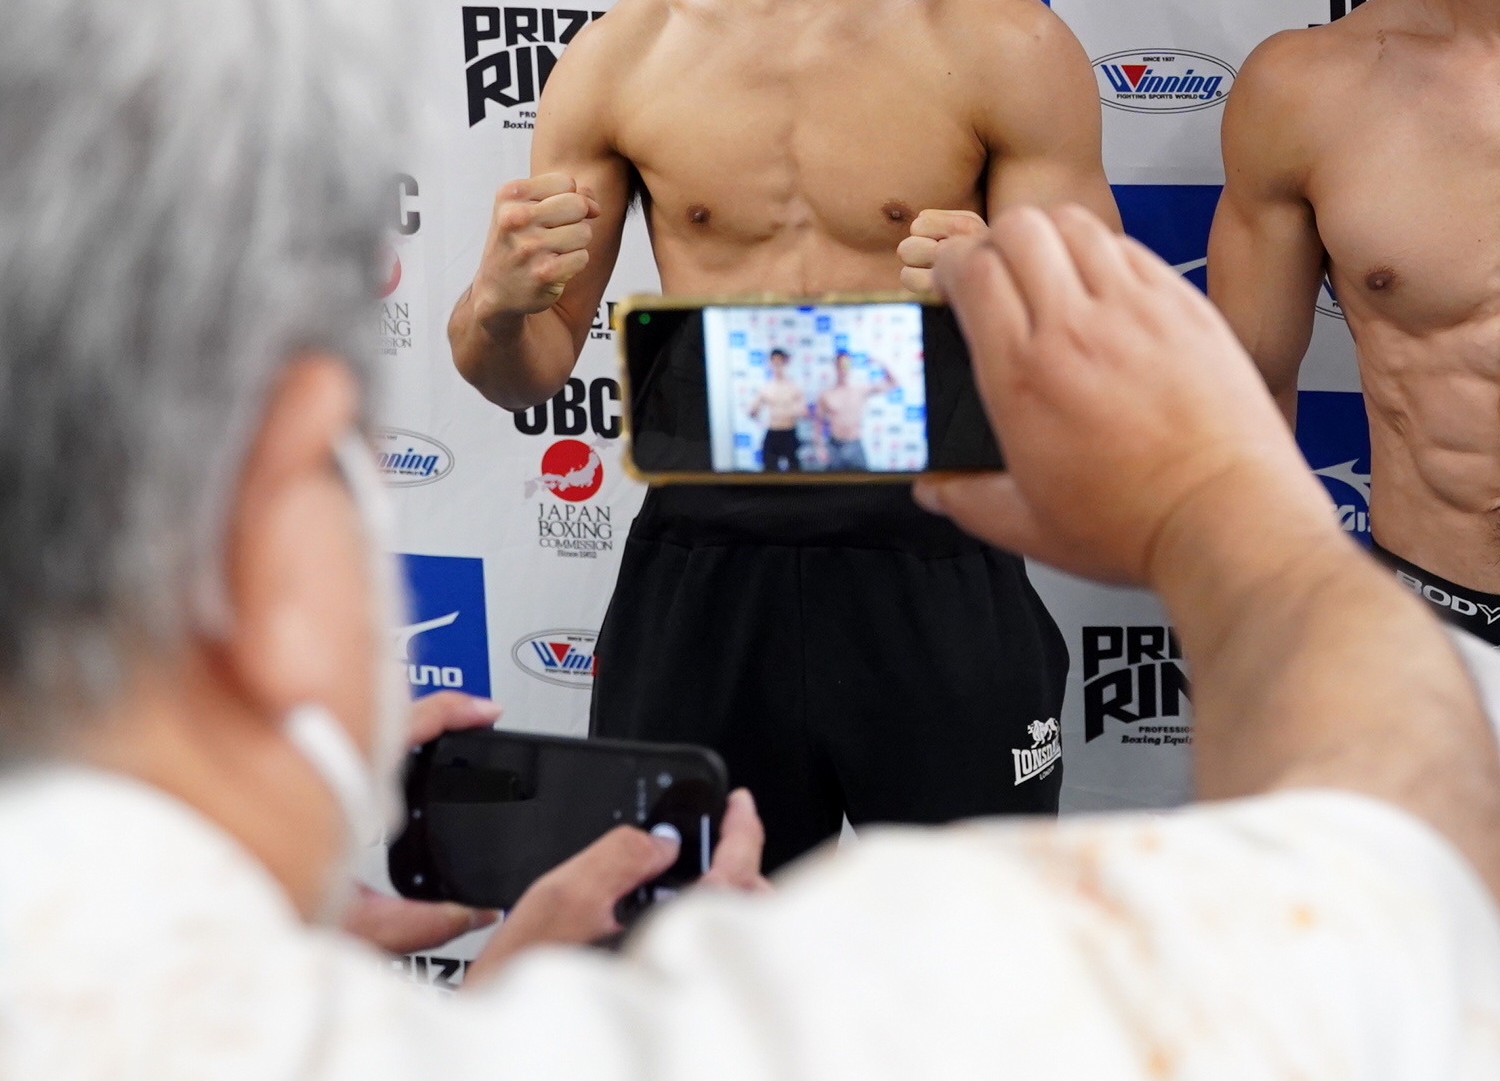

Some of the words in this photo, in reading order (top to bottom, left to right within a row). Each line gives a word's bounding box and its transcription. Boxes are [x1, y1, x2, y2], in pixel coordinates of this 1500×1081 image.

[462, 6, 608, 64] PRIZ
[1101, 65, 1222, 99] Winning
[539, 503, 608, 521] JAPAN
[539, 520, 610, 539] BOXING
